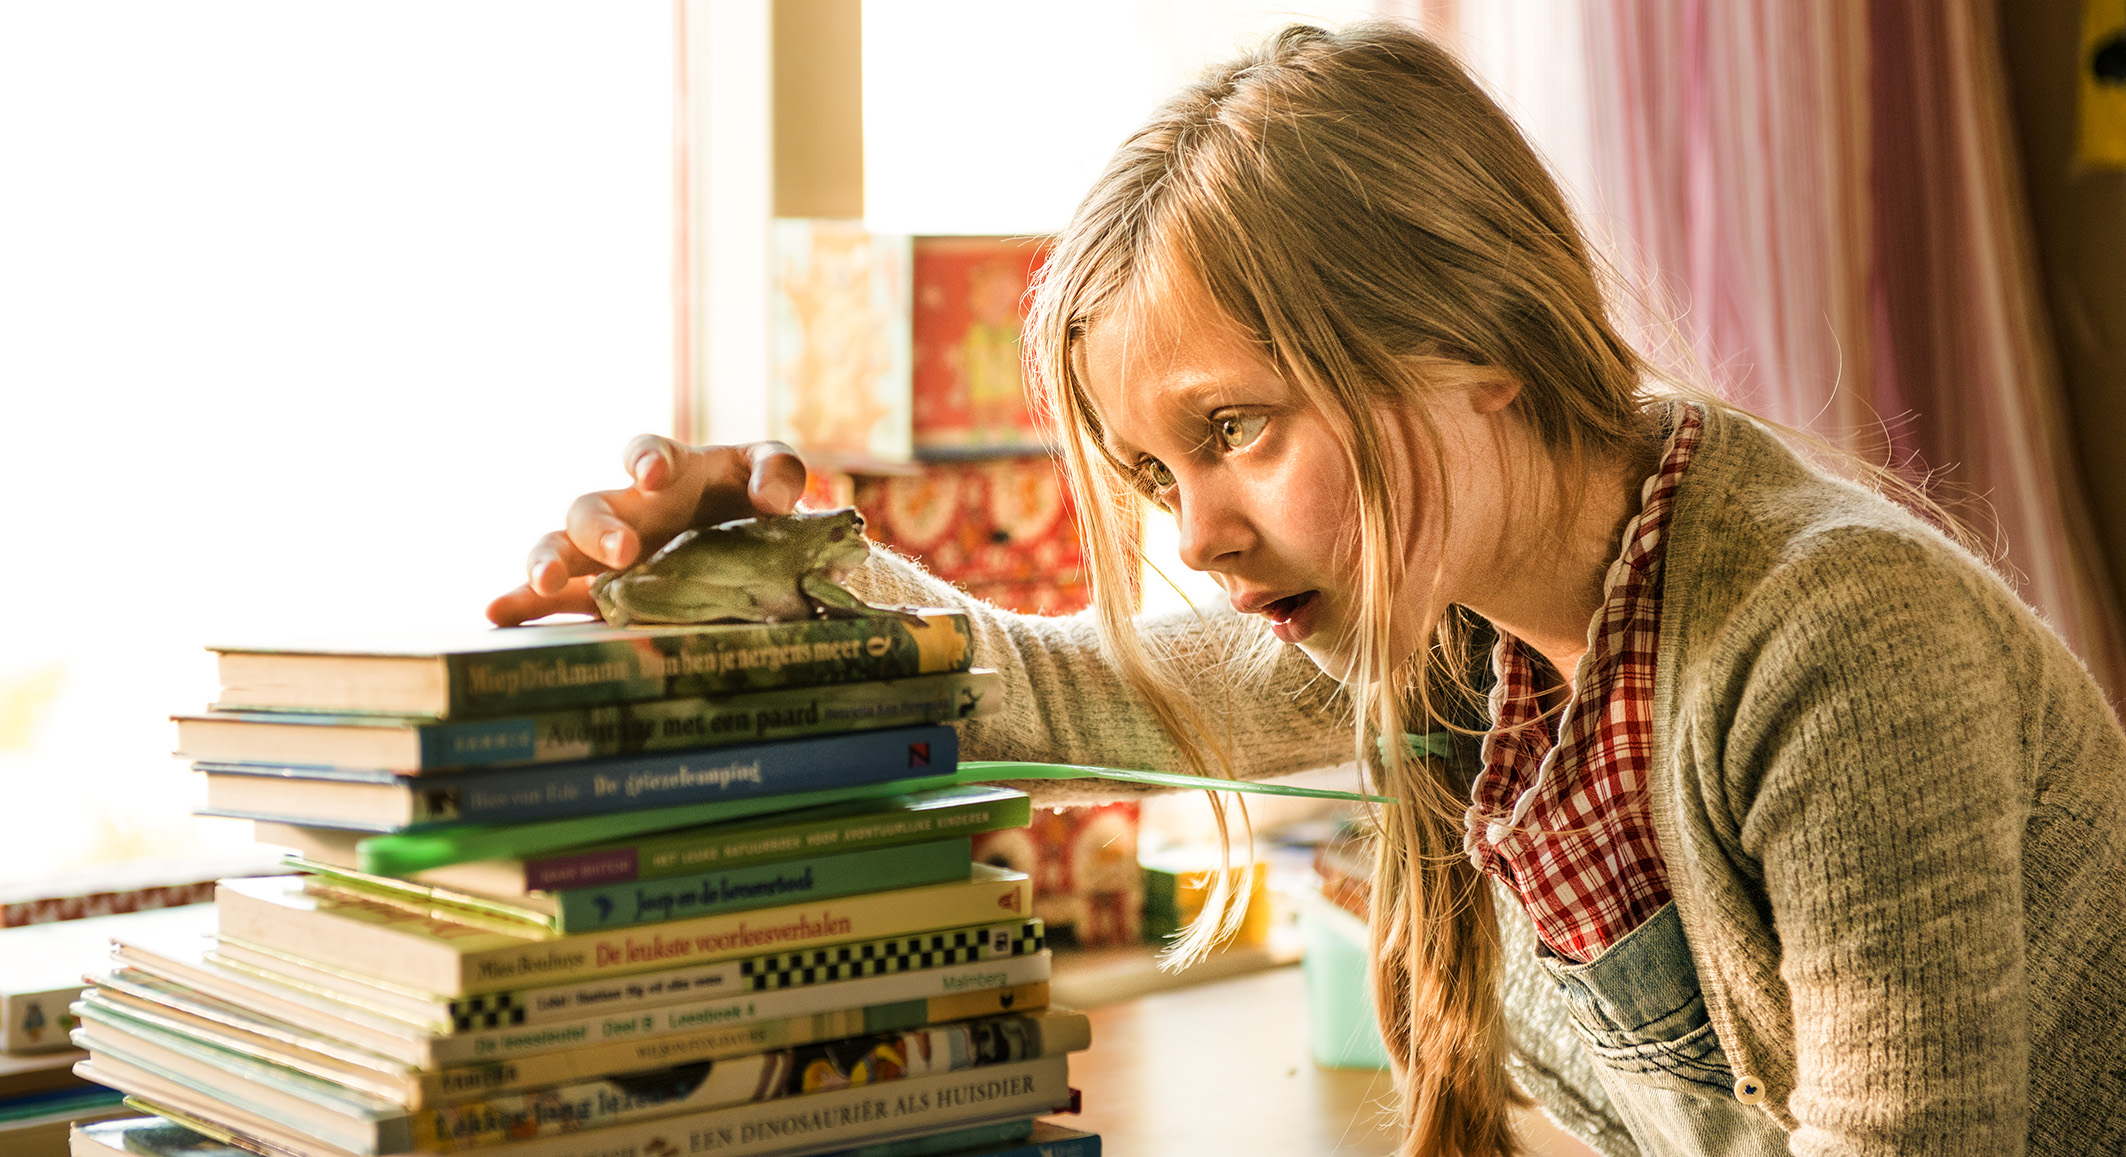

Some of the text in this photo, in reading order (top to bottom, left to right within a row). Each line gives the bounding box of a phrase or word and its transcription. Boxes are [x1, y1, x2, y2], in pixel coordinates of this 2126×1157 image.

[596, 911, 852, 969] De leukste voorleesverhalen
[689, 1125, 735, 1152] EEN
[894, 1093, 931, 1117] ALS
[937, 1073, 1036, 1109] HUISDIER
